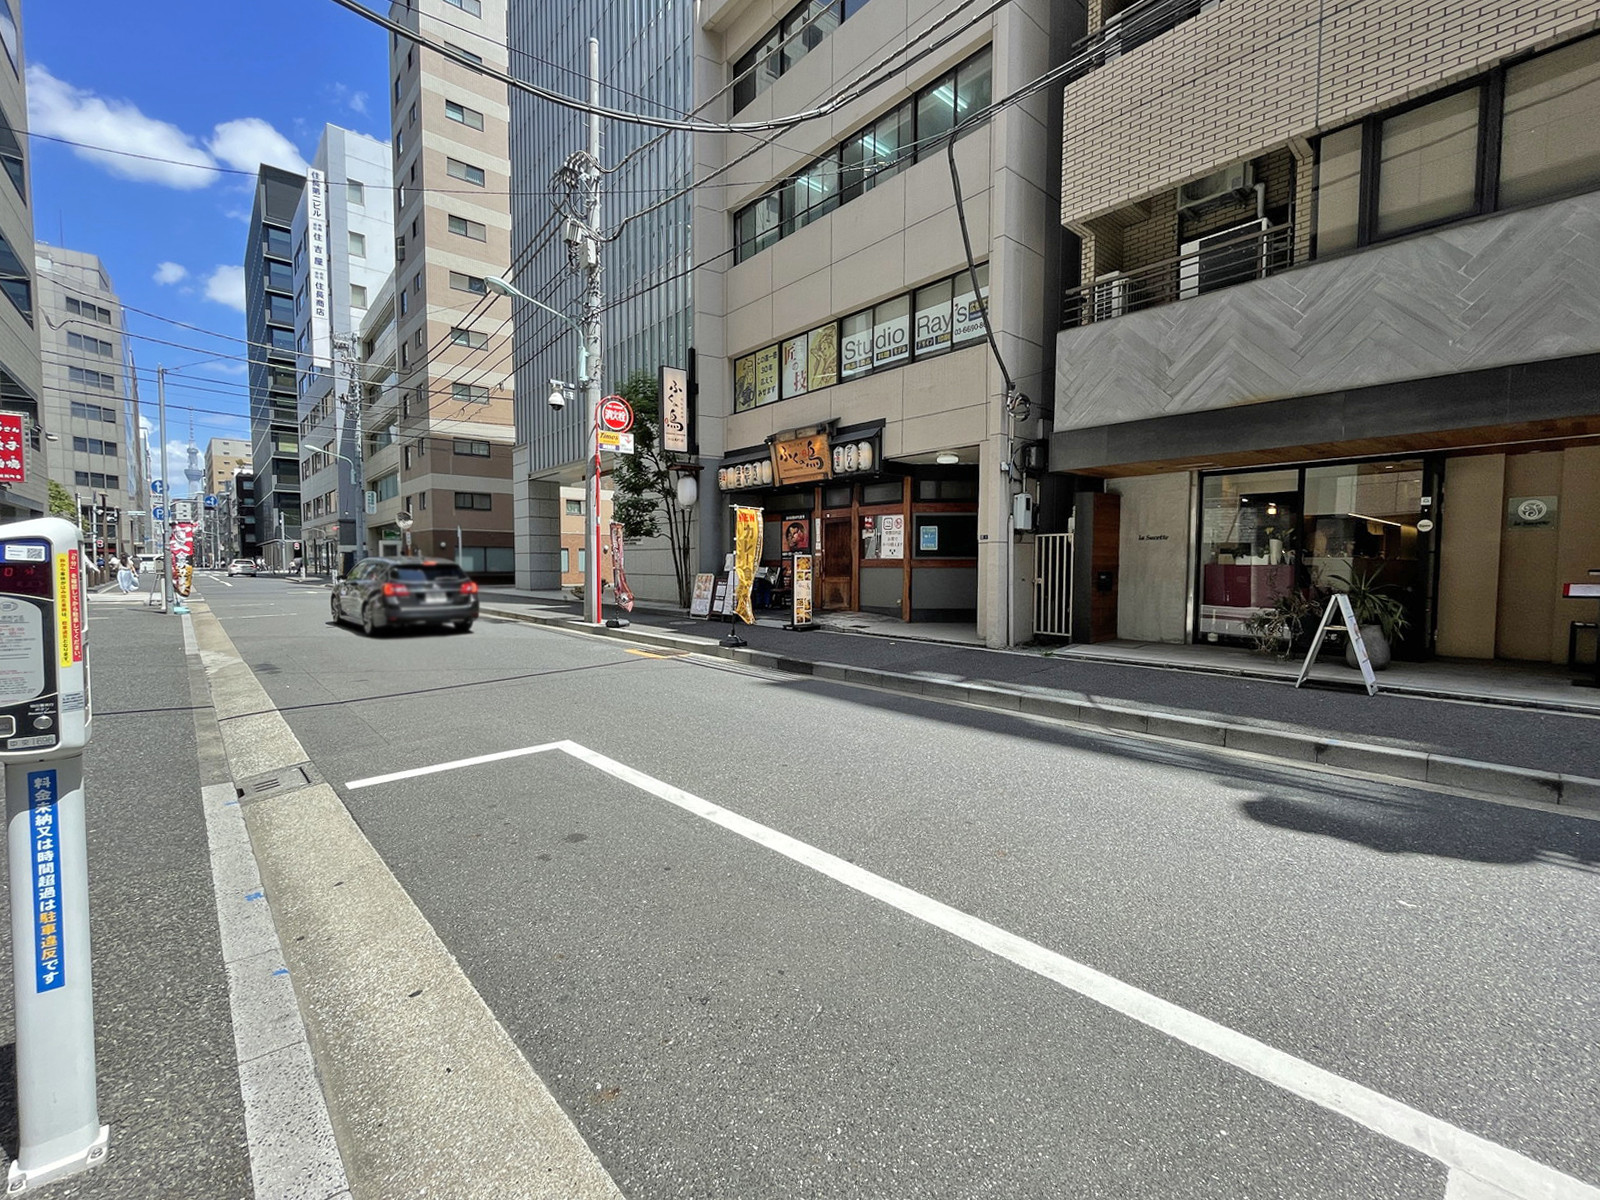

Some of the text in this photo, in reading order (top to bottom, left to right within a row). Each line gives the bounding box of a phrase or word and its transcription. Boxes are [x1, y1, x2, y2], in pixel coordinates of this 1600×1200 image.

[845, 327, 905, 360] Studio
[917, 303, 967, 338] Ray's
[738, 513, 755, 523] NEW
[33, 777, 60, 985] 料金未納又は時間超過は駐車違反です
